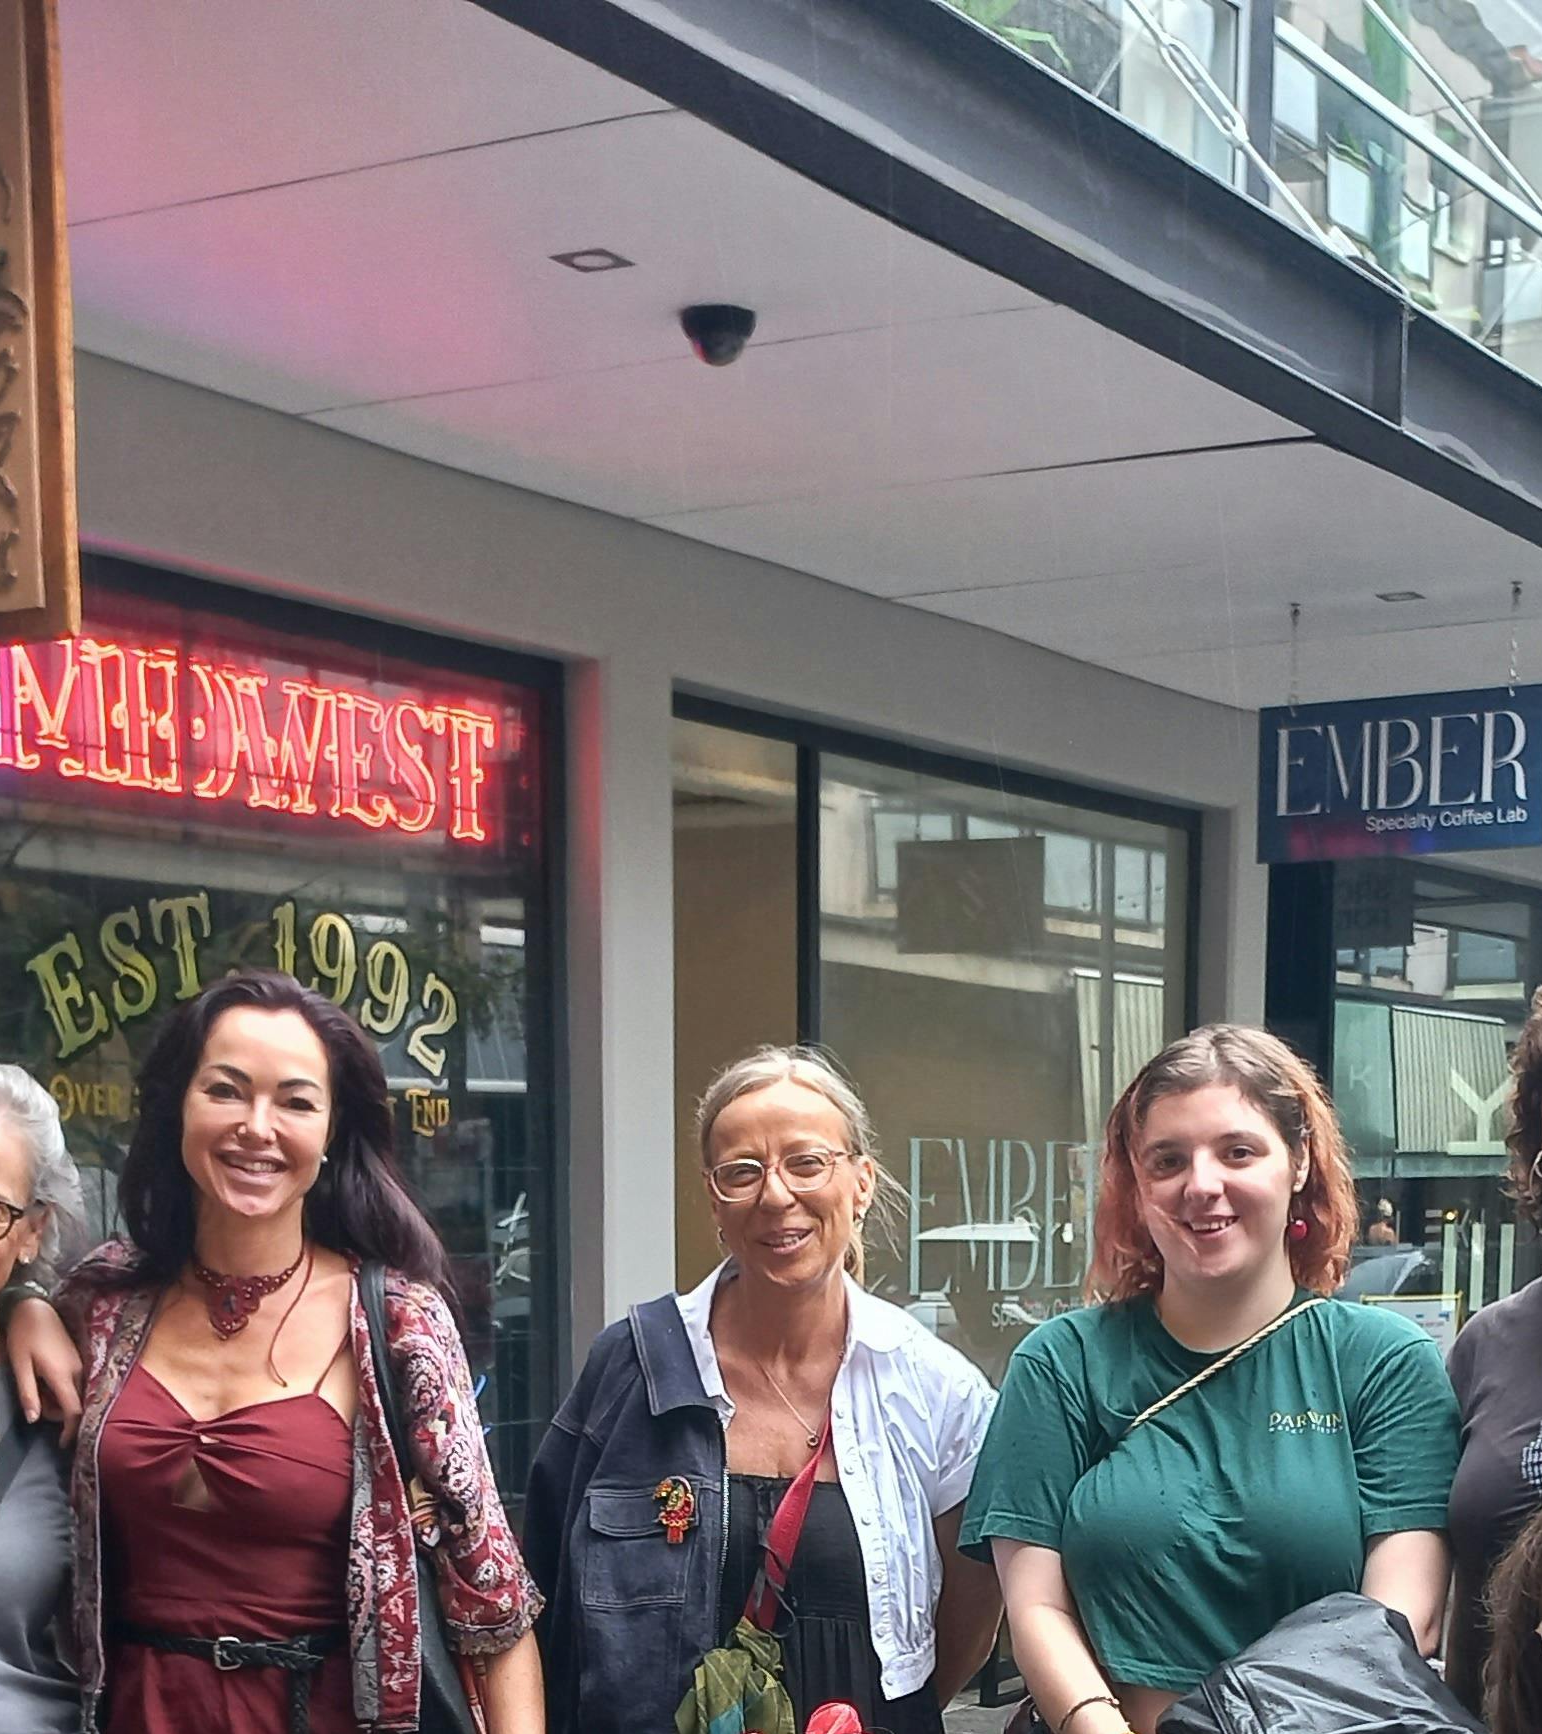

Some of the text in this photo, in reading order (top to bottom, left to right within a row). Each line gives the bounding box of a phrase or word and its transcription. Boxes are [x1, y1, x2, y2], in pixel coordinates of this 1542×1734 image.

[1276, 709, 1529, 817] EMBER
[1365, 804, 1529, 834] Specialty Coffee Lab
[270, 899, 459, 1078] 1992
[908, 1136, 1097, 1297] EMBE
